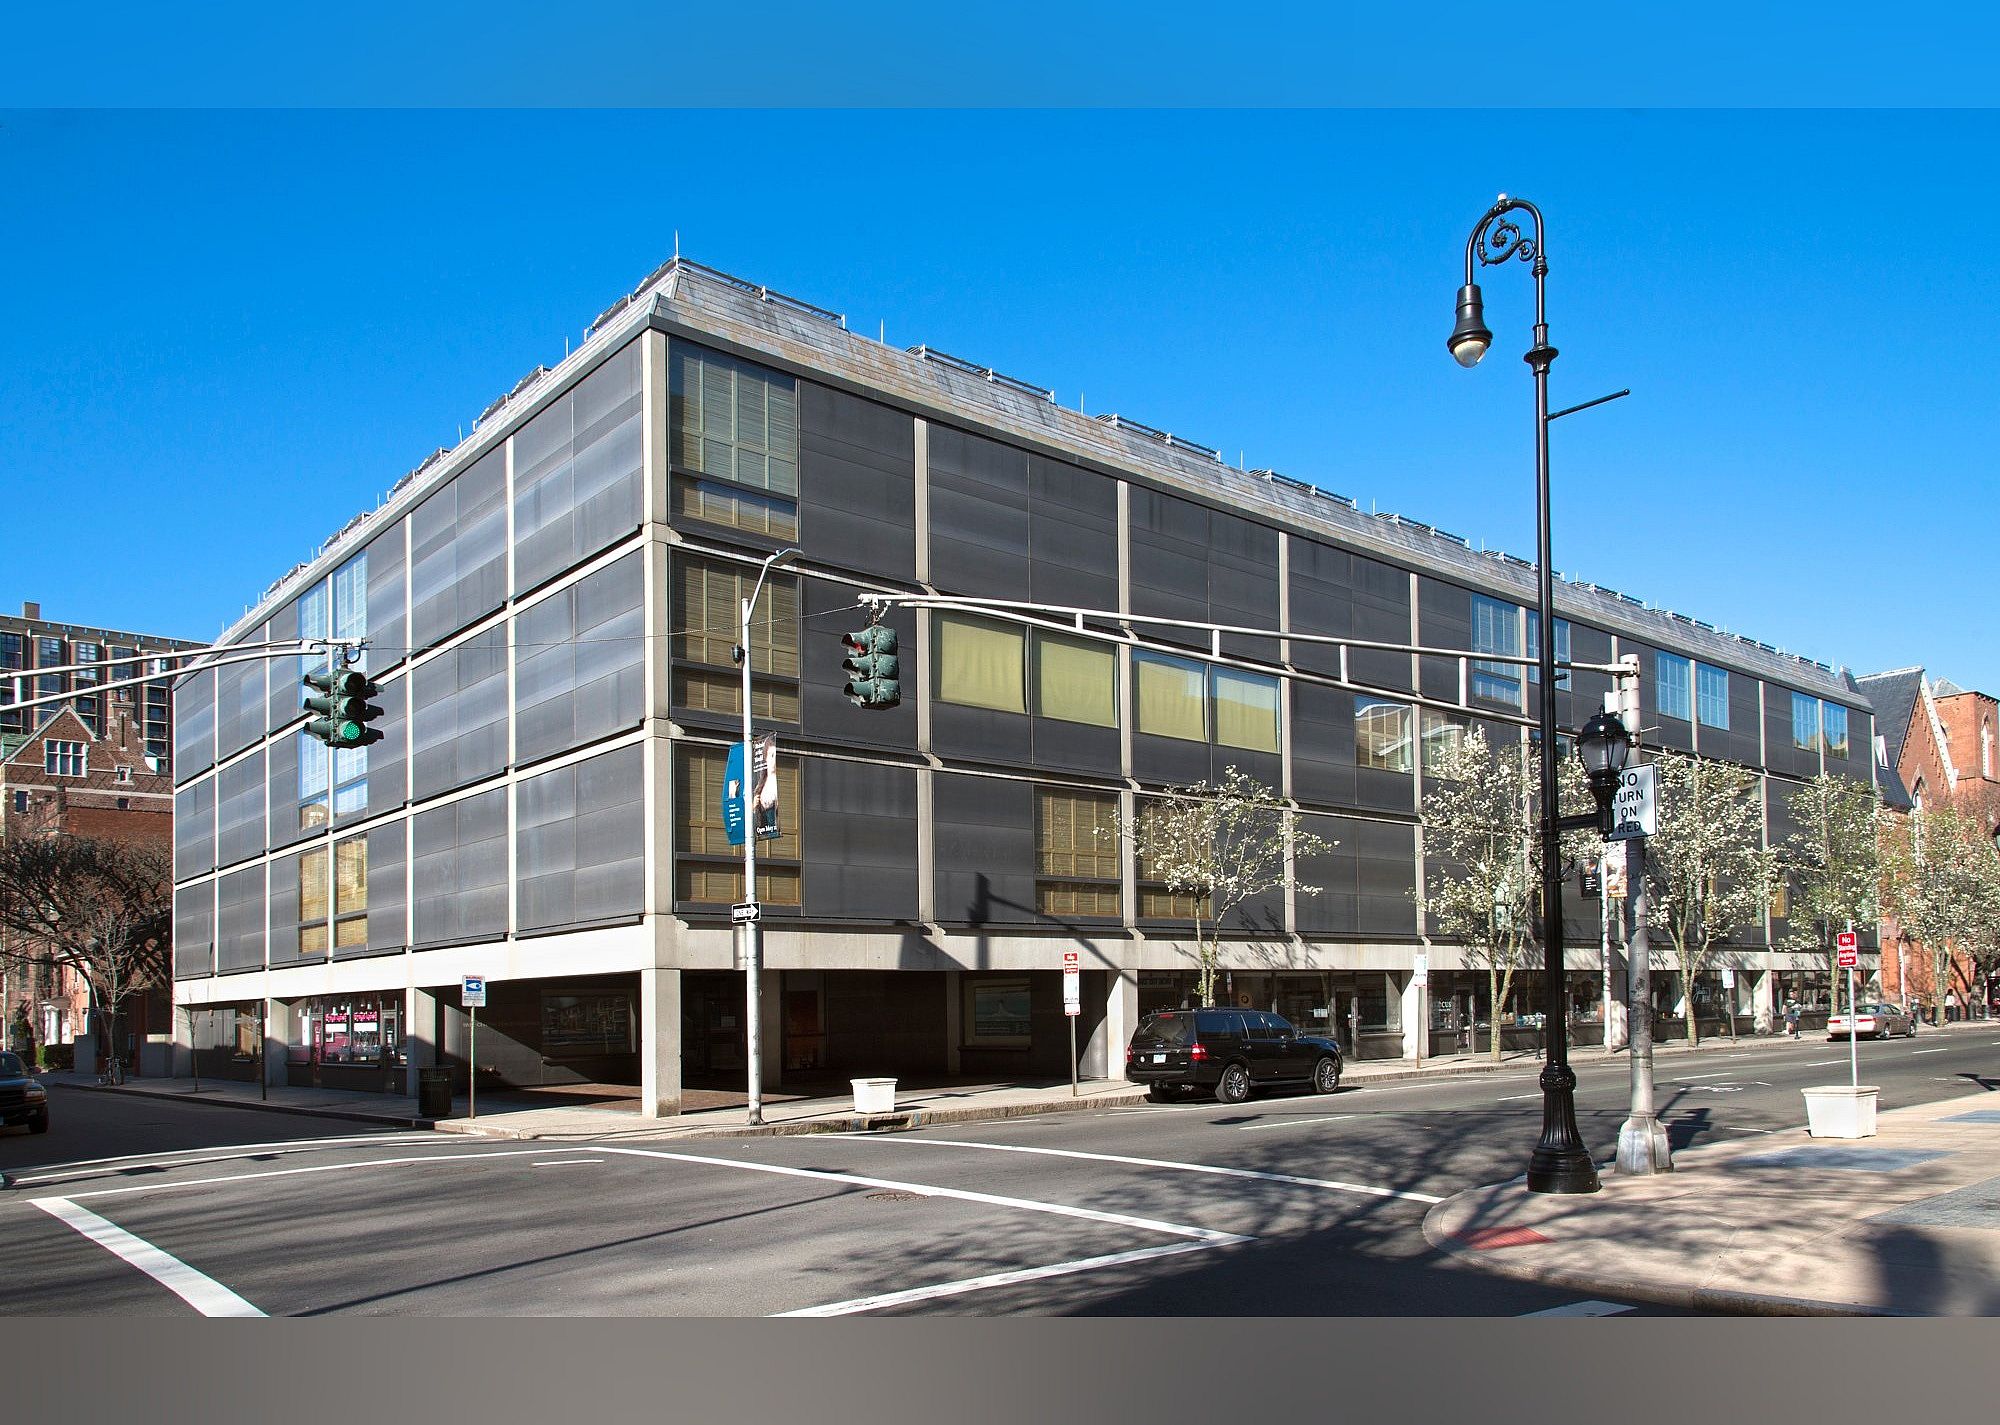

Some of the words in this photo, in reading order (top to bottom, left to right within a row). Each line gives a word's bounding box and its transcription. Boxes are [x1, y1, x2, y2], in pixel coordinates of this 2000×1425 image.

[1617, 773, 1638, 787] NO
[1621, 805, 1637, 818] ON
[1618, 821, 1641, 833] RED
[1841, 936, 1851, 944] No
